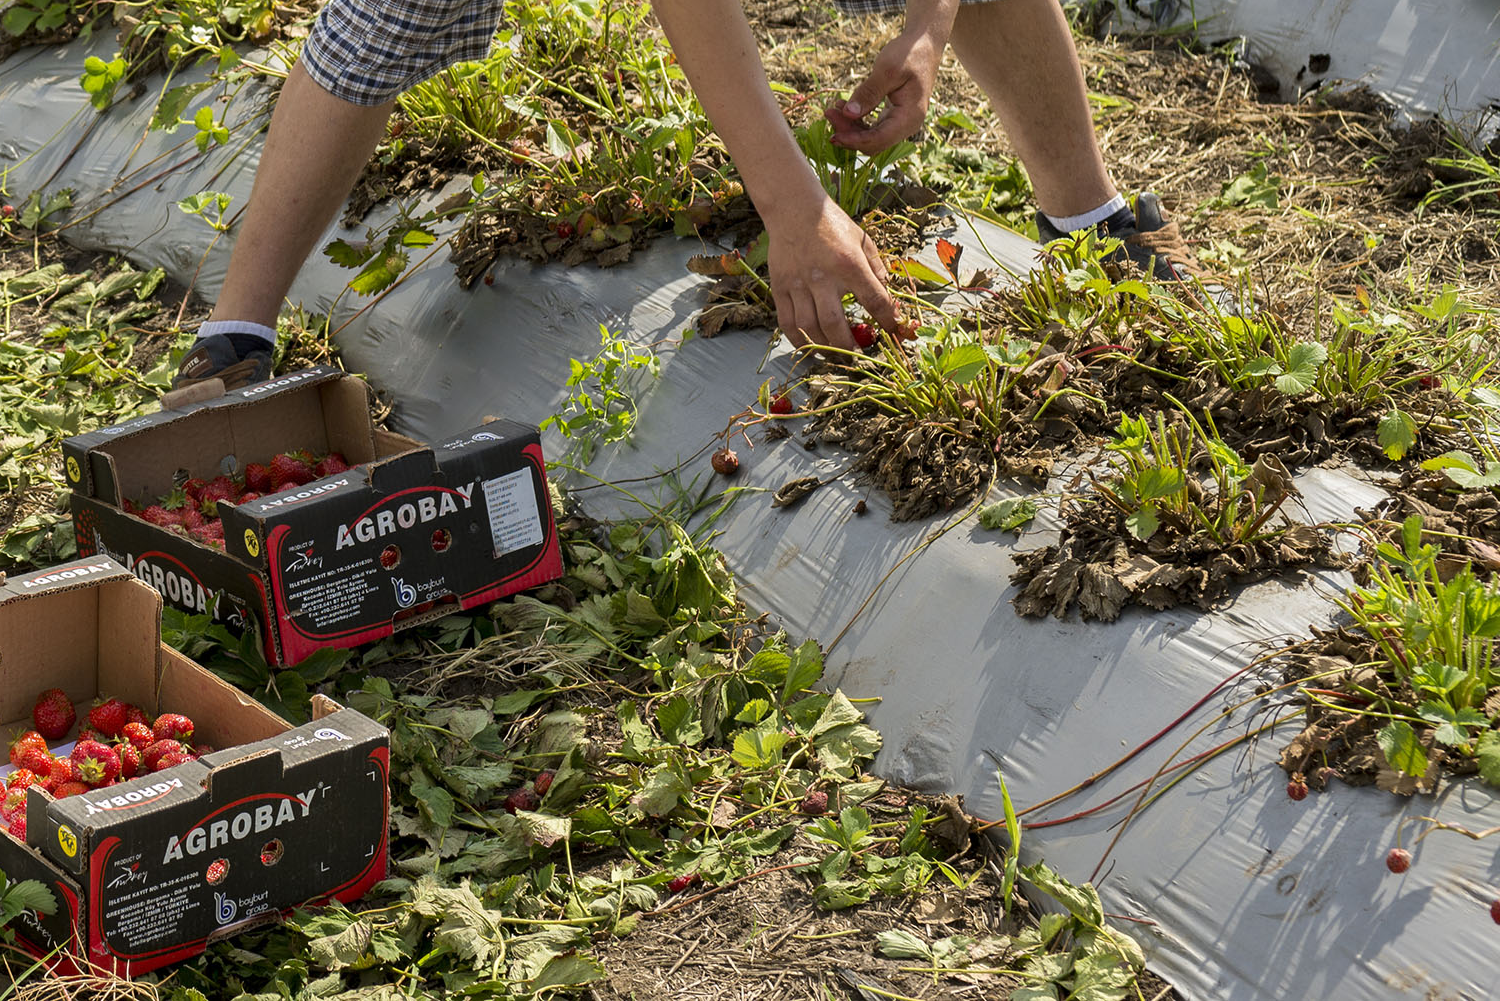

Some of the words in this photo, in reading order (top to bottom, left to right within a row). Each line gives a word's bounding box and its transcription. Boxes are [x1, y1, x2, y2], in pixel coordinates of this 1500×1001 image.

[243, 369, 323, 397] AGROBAY
[259, 480, 349, 511] AGROBAY
[336, 483, 475, 550] AGROBAY
[22, 561, 112, 588] AGROBAY
[416, 576, 445, 592] bayburt
[83, 778, 184, 816] AGROBAY
[163, 789, 316, 865] AGROBAY
[113, 855, 136, 867] PRODUCT
[135, 853, 142, 861] OF
[239, 890, 269, 908] bayburt
[246, 901, 269, 919] group
